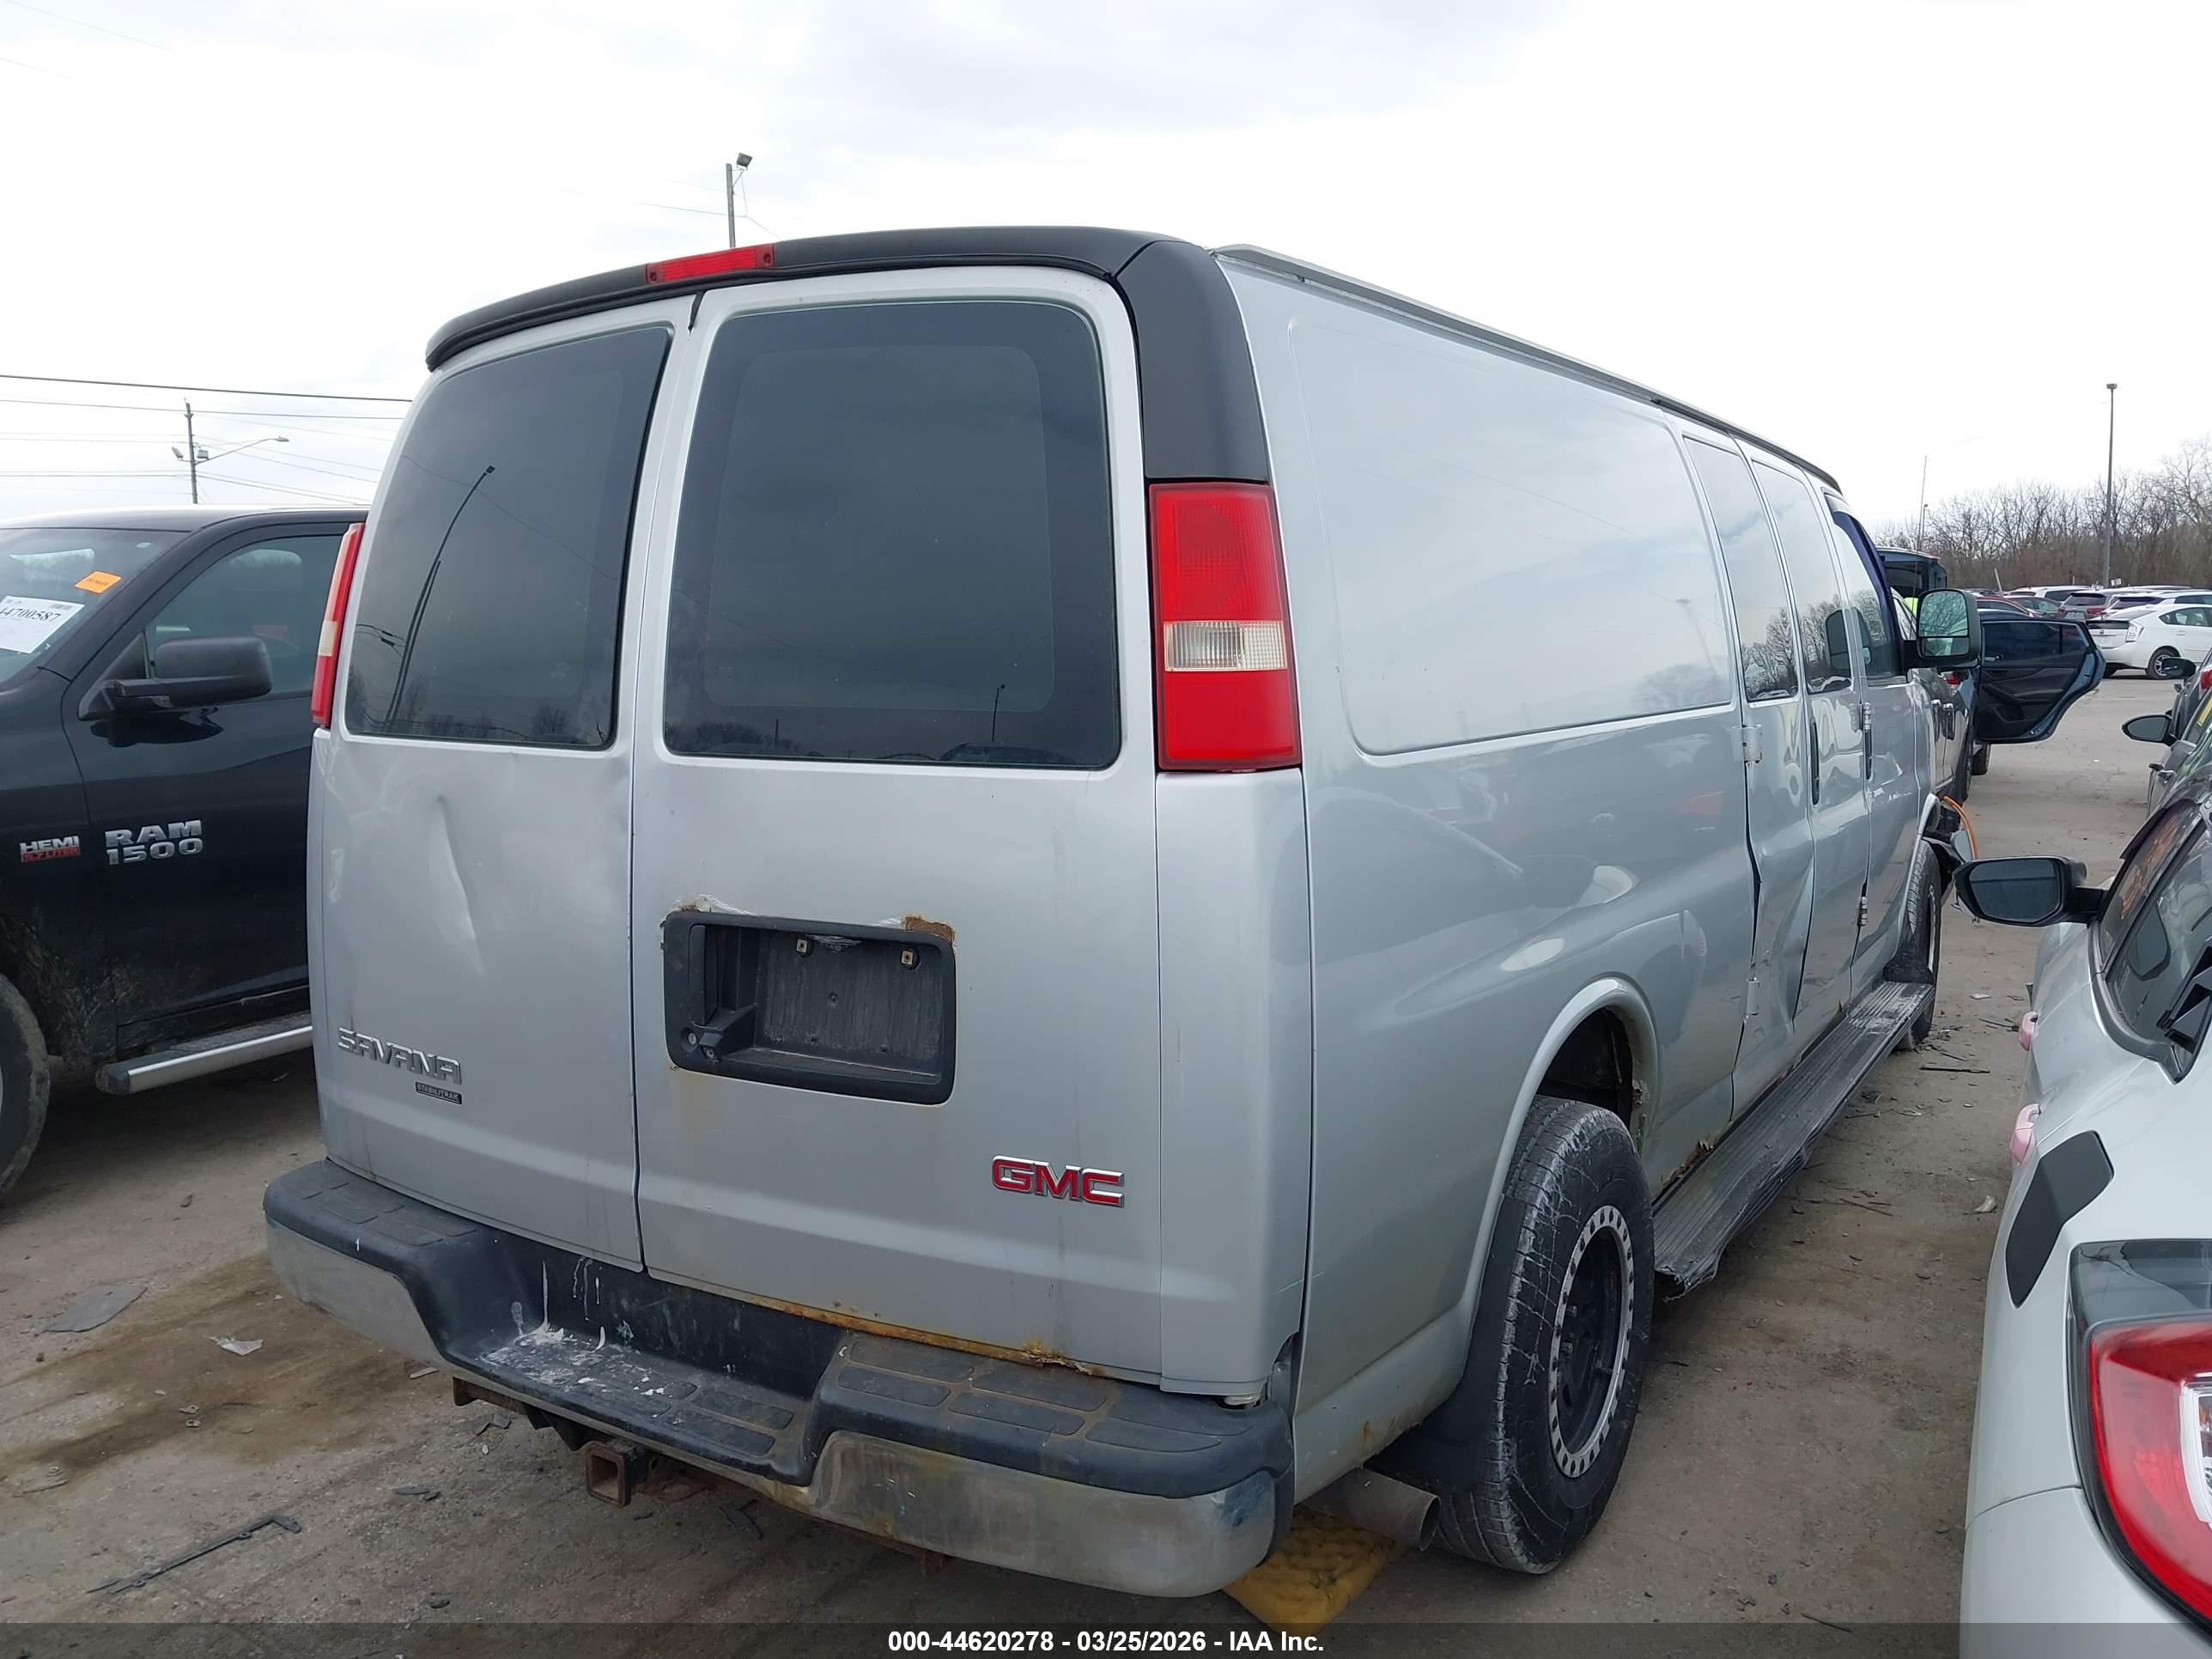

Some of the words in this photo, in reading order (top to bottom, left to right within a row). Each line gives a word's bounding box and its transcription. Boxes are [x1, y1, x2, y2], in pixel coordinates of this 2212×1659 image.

[19, 836, 80, 853] HEMI
[105, 819, 202, 848] RAM
[46, 847, 80, 859] LITER
[106, 837, 204, 865] 1500
[337, 1027, 462, 1085] SAVANA
[416, 1083, 461, 1102] STABILITRAK
[992, 1155, 1124, 1208] GMC
